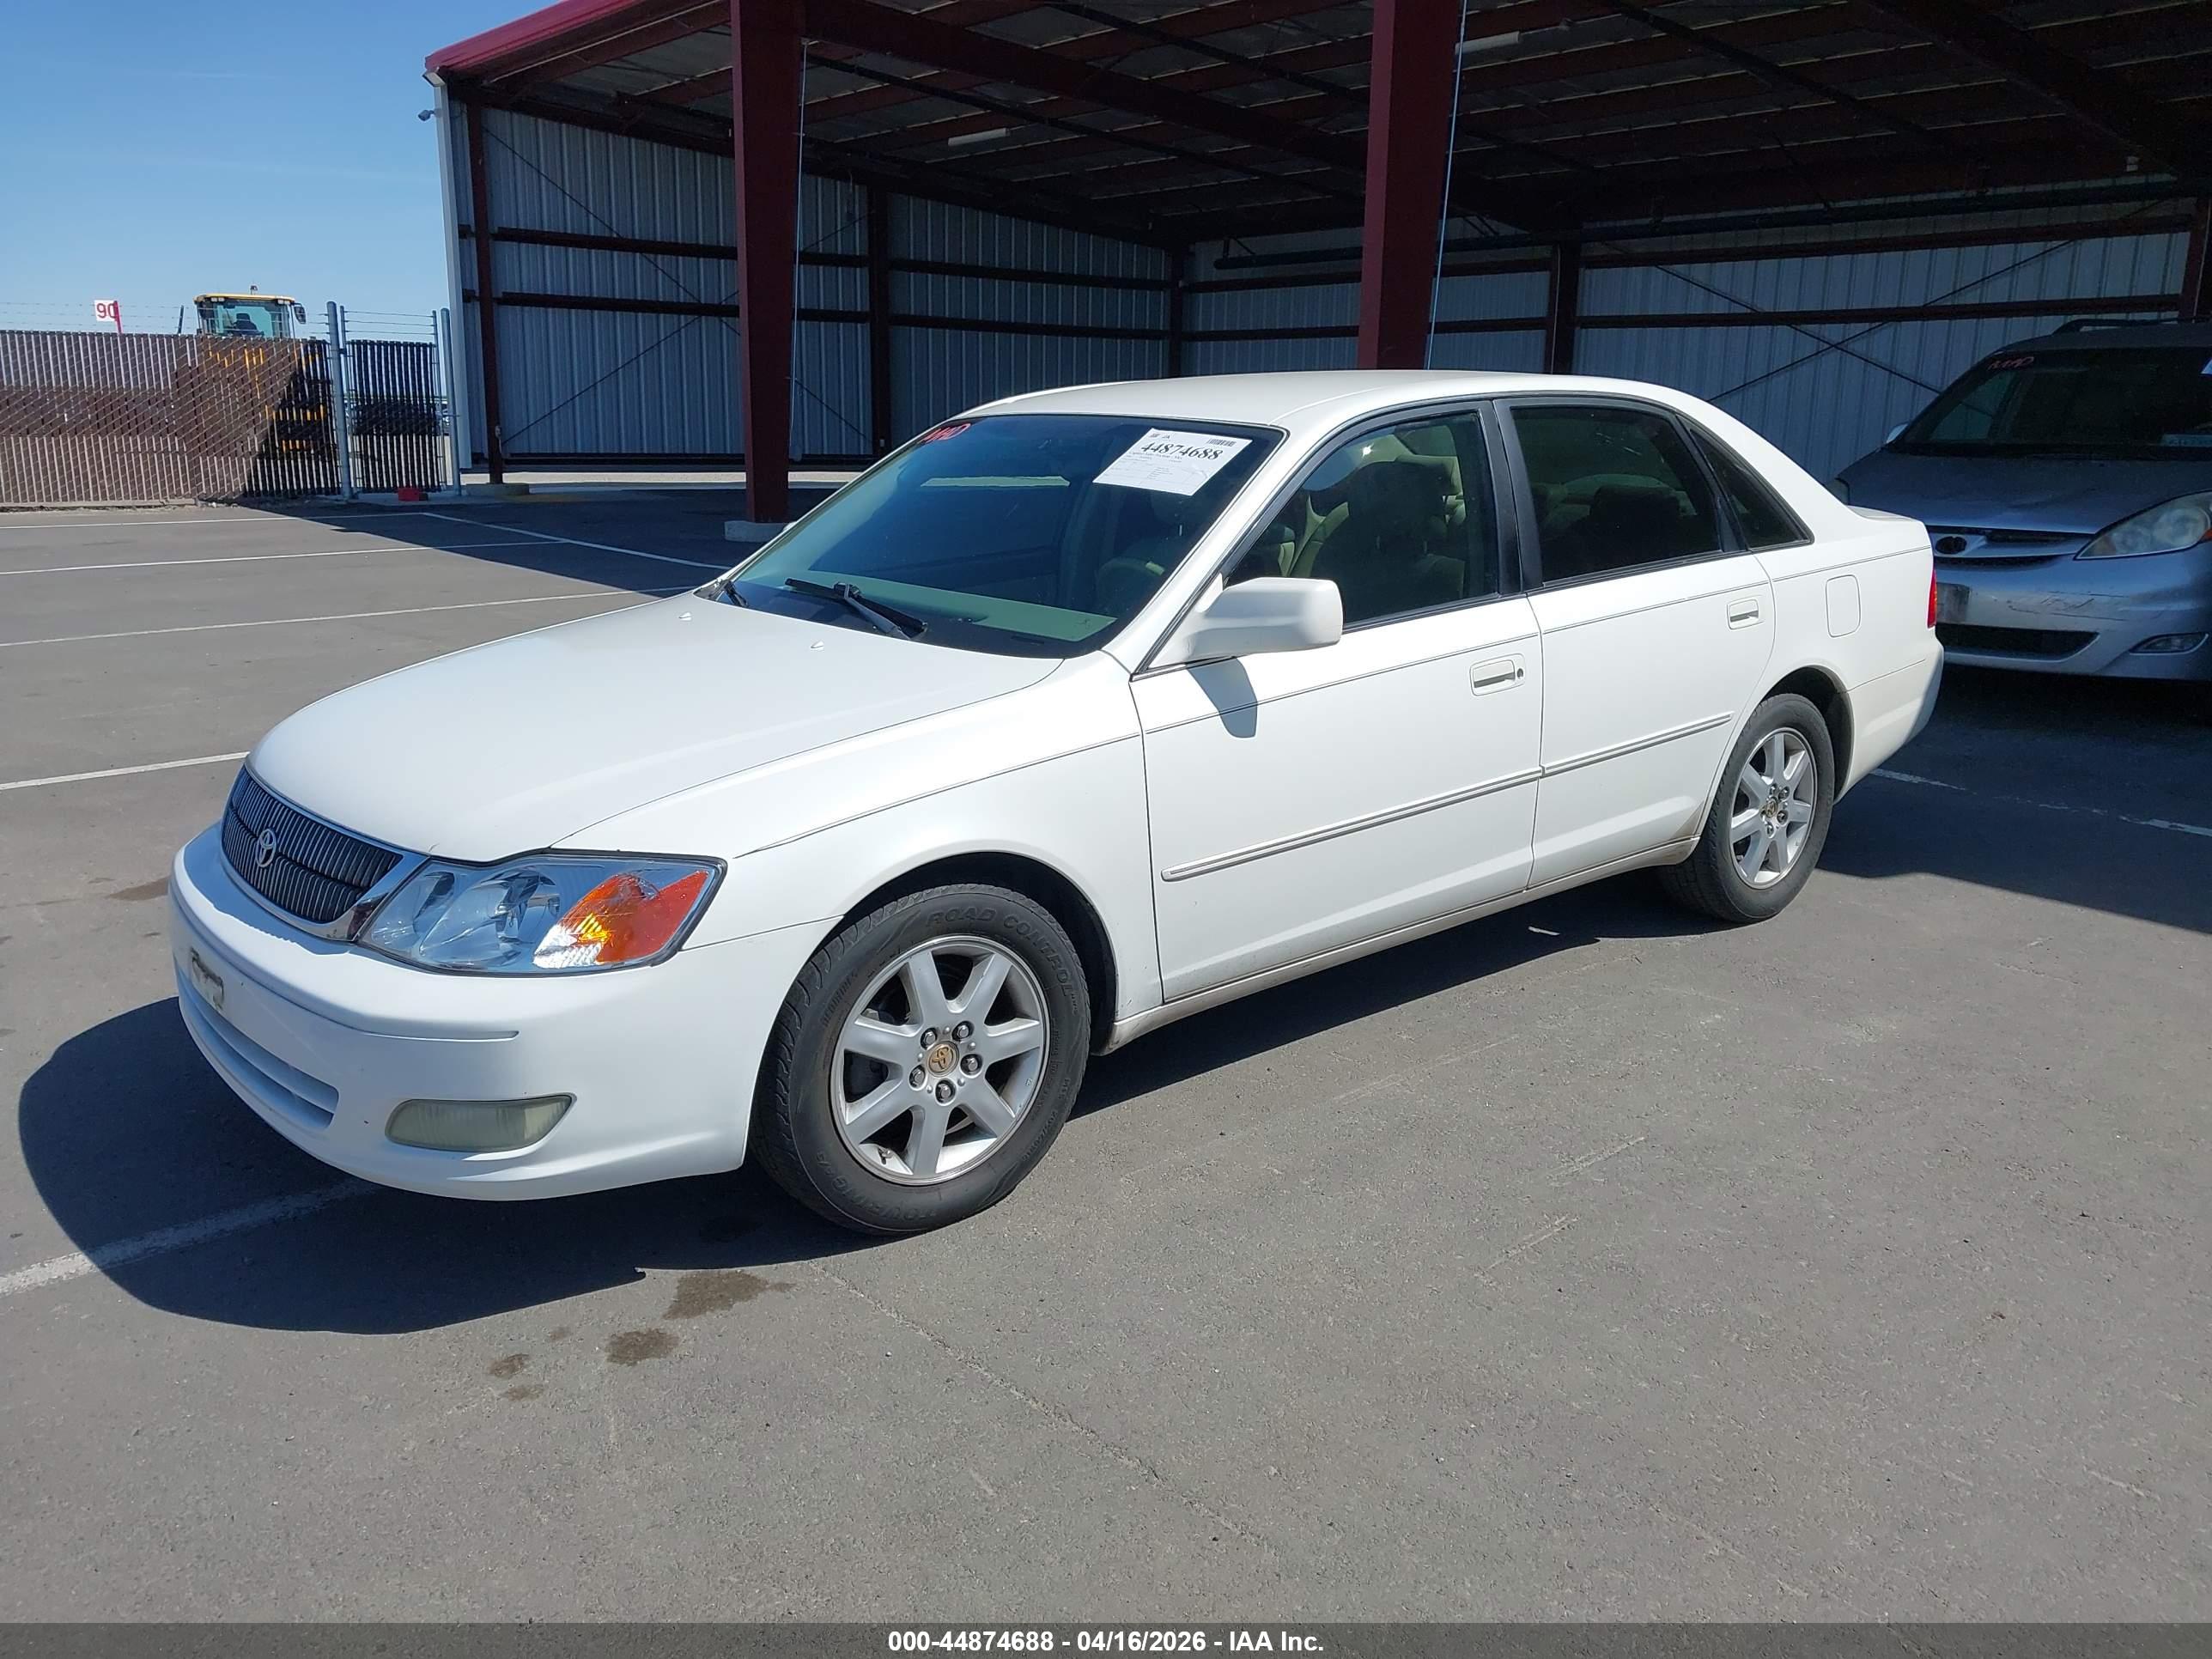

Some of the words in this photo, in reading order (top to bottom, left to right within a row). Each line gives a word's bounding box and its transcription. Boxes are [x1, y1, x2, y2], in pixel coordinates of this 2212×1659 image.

[96, 302, 117, 319] 90
[1140, 441, 1224, 460] 44874688
[926, 906, 997, 927] ROAD
[1003, 913, 1073, 997] CONTROL
